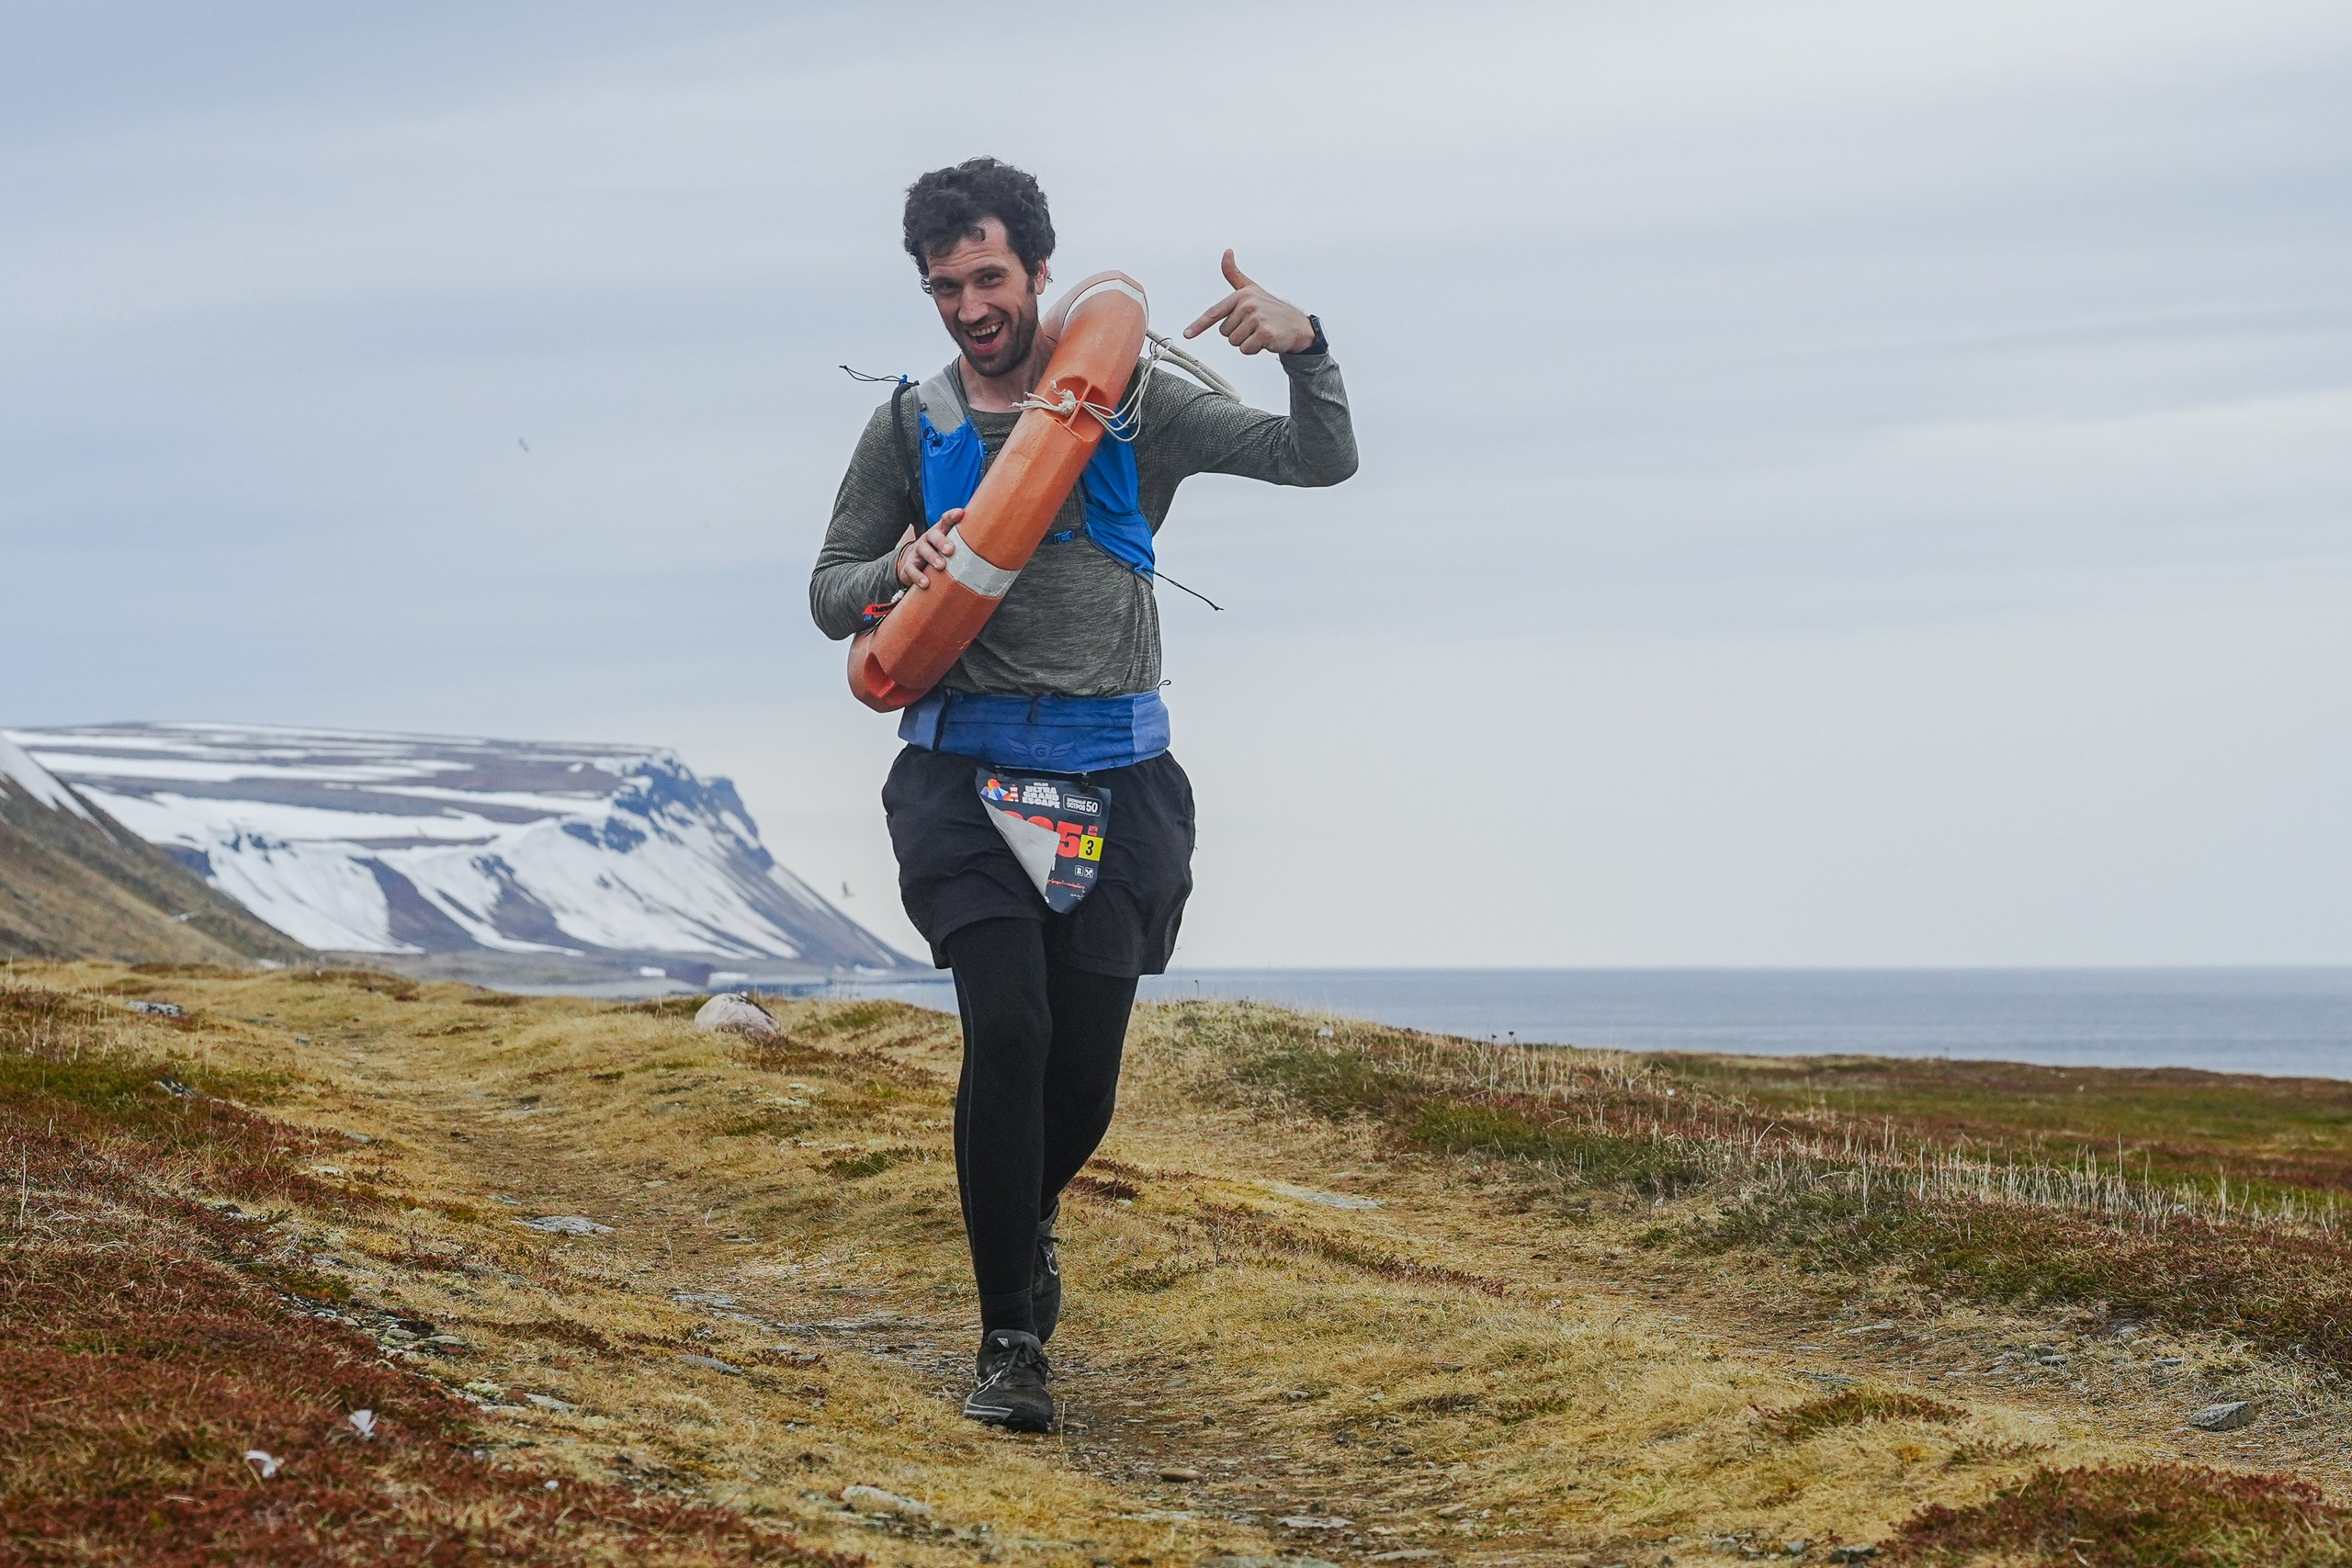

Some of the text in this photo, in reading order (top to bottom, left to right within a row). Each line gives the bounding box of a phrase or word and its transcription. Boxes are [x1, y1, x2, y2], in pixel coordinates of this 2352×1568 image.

[1023, 791, 1059, 801] GRAND
[1024, 785, 1057, 795] ULTRA
[1022, 796, 1060, 808] ESCAPE
[1086, 801, 1098, 813] 50
[1085, 840, 1094, 856] 3
